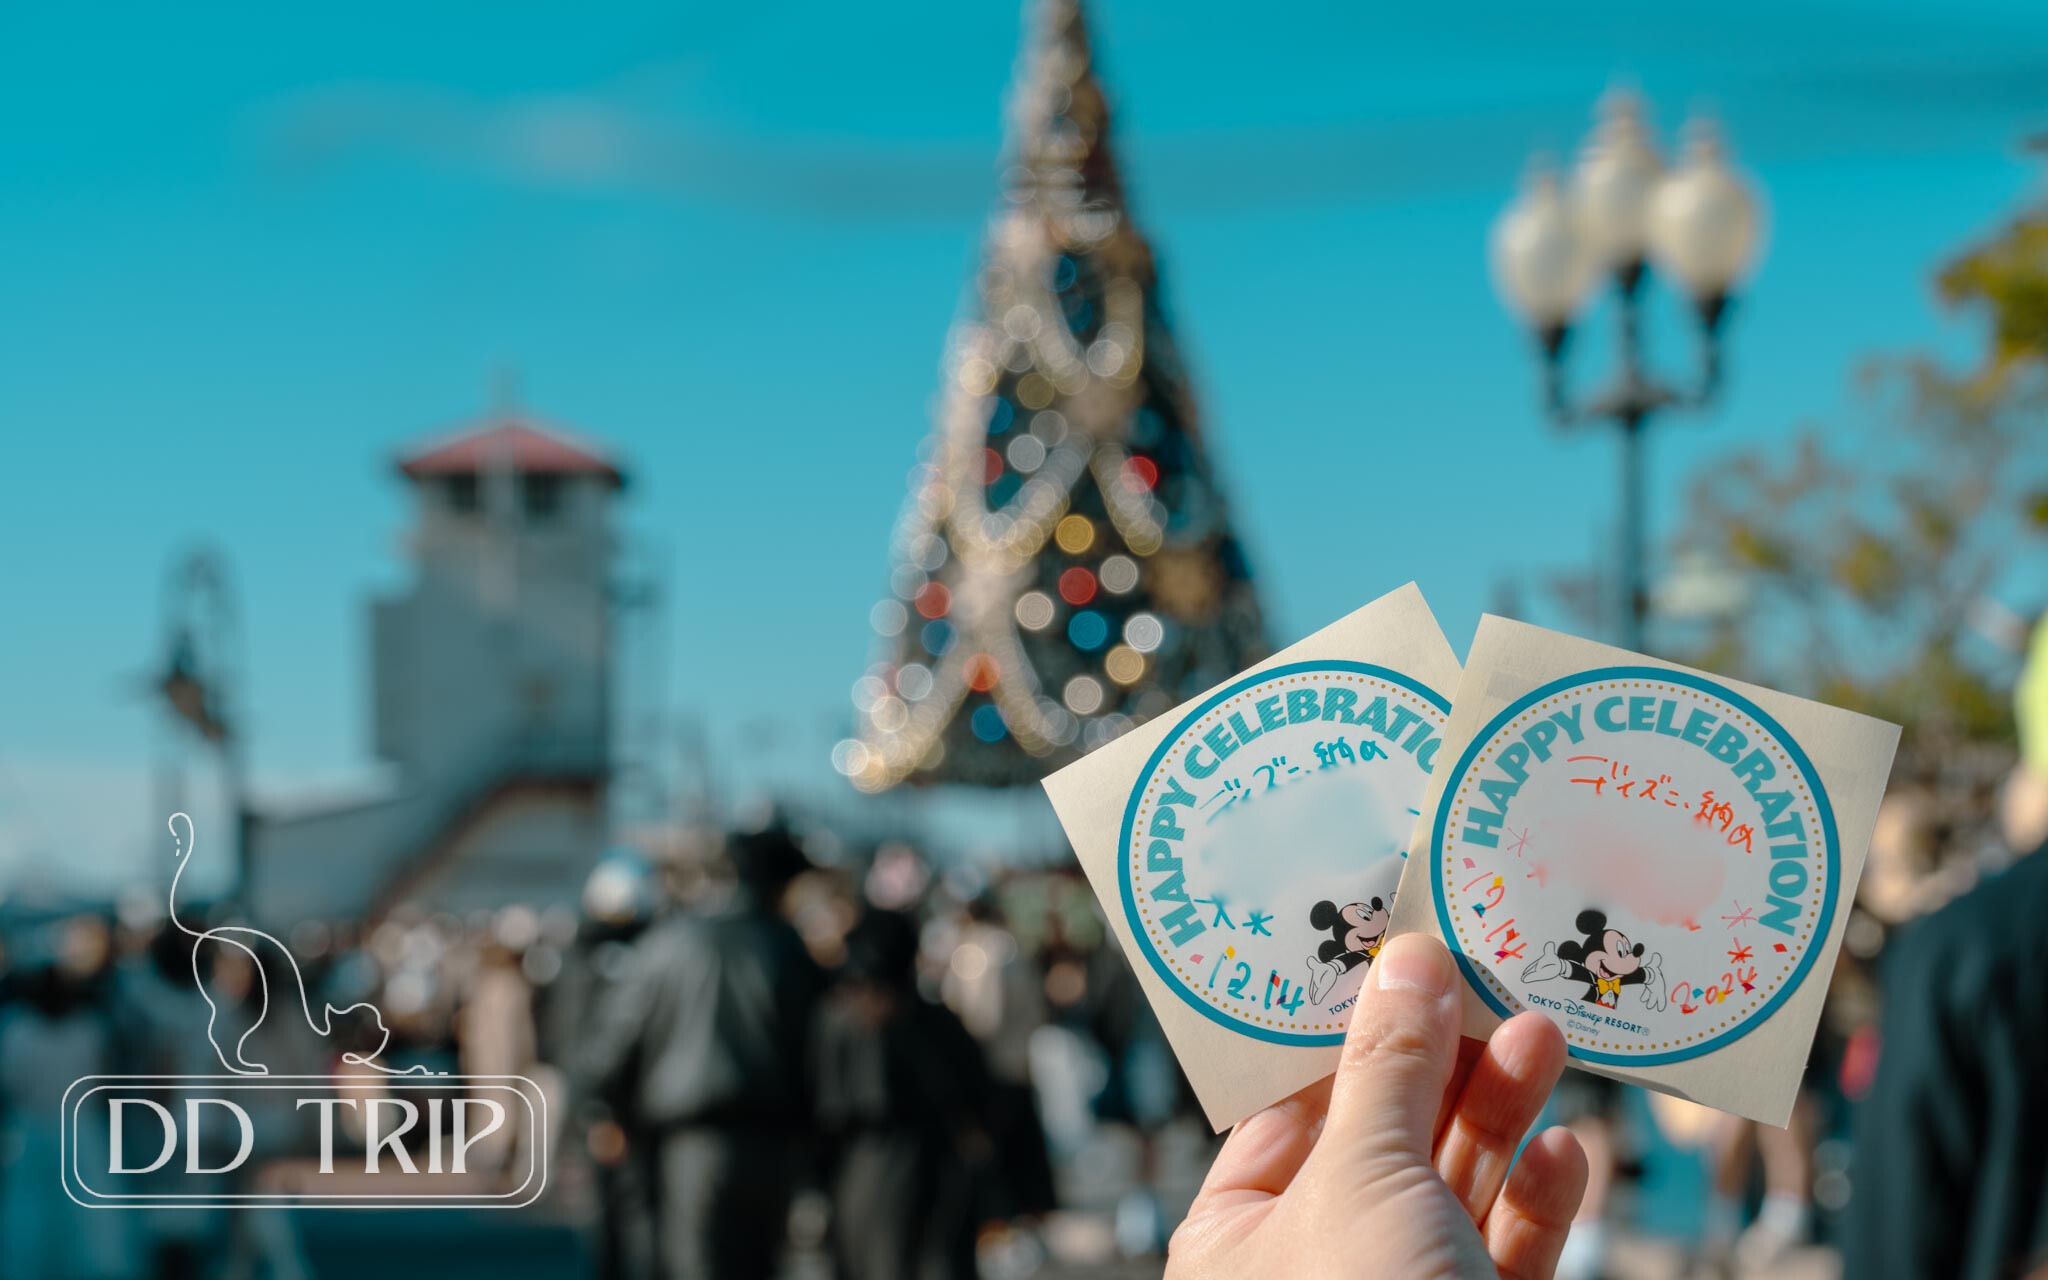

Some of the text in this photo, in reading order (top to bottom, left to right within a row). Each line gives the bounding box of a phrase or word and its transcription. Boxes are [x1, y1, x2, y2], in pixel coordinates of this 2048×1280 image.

[1147, 776, 1207, 948] HAPPY
[1184, 687, 1442, 779] CELEBRATIO
[1462, 704, 1585, 848] HAPPY
[1594, 696, 1809, 937] CELEBRATION
[1462, 871, 1528, 964] 12.14
[1208, 953, 1305, 1017] 12.14
[1527, 993, 1562, 1010] TOKYO
[1670, 966, 1759, 1014] 2024
